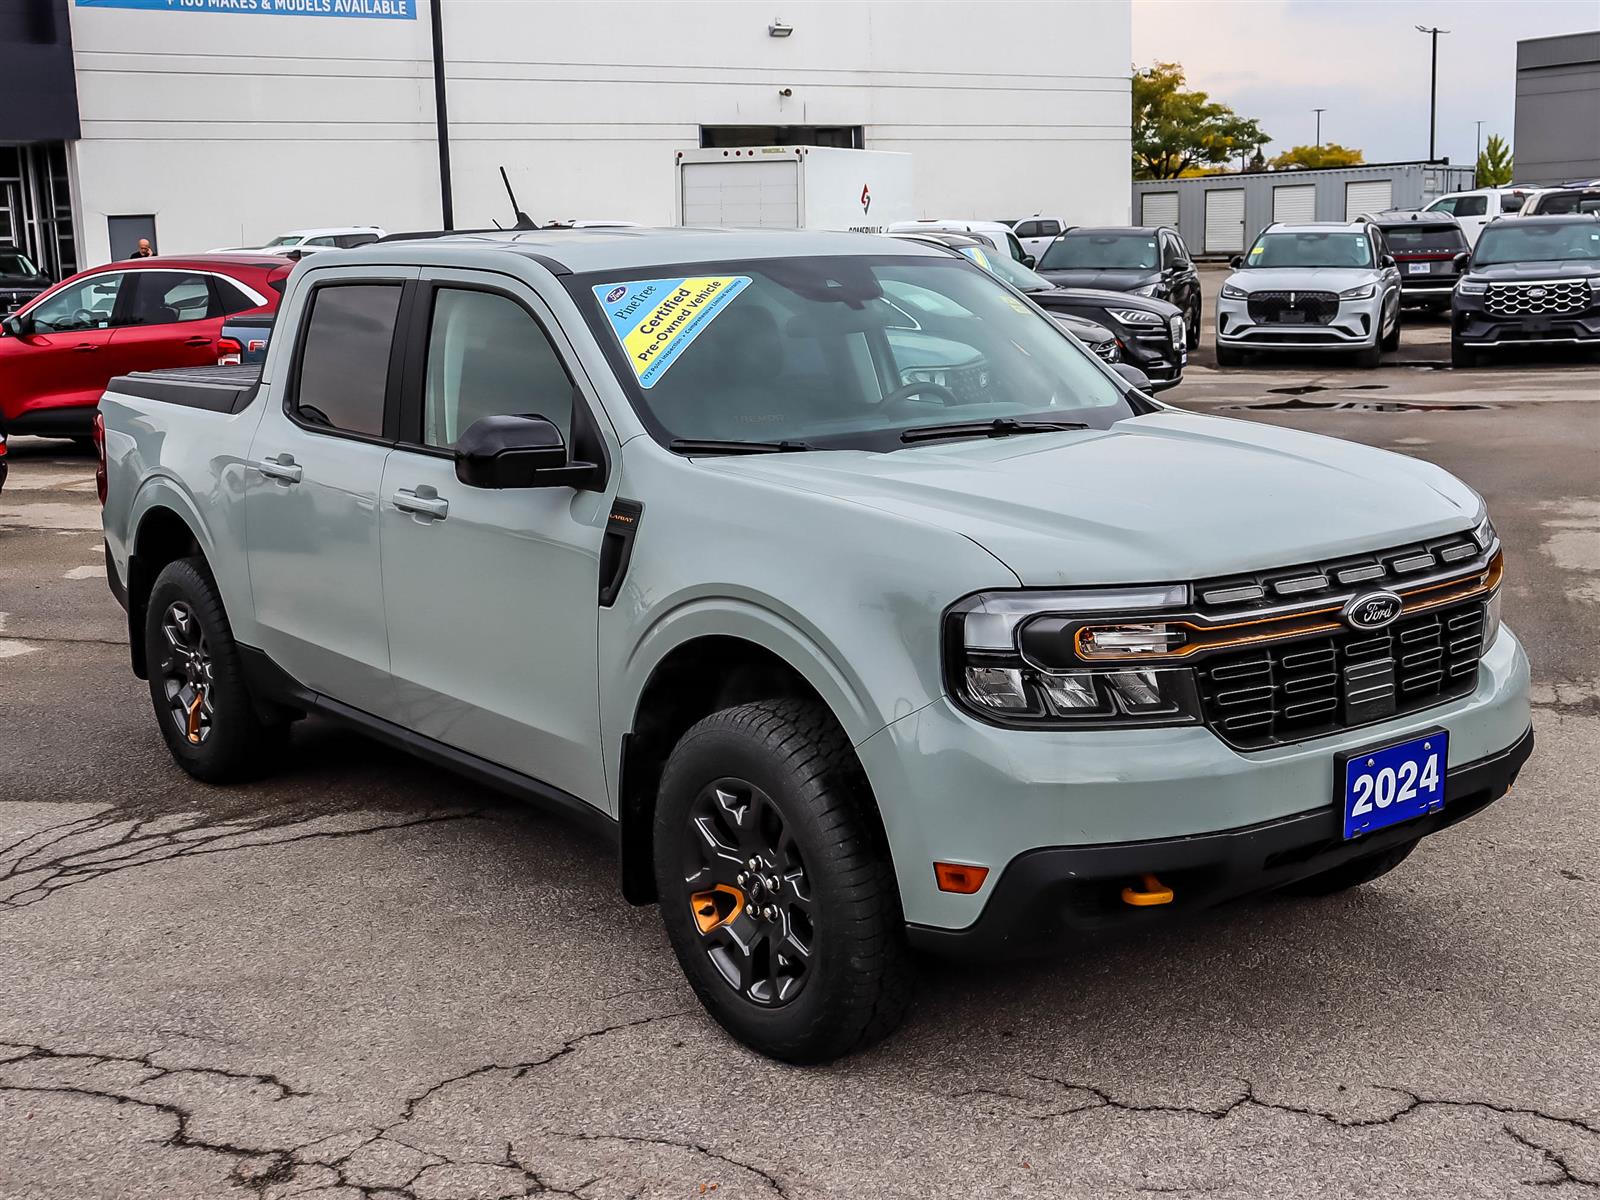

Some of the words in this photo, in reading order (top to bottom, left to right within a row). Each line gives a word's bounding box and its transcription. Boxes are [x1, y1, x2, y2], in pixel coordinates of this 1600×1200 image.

[208, 0, 257, 9] MAKES
[274, 0, 331, 12] MODELS
[334, 0, 407, 15] AVAILABLE
[614, 284, 657, 320] PineTree
[640, 288, 691, 335] Certified
[638, 309, 692, 361] Pre-Owned
[687, 280, 721, 308] Vehicle
[651, 359, 664, 372] Point
[1363, 600, 1393, 623] Ford
[1351, 753, 1439, 818] 2024
